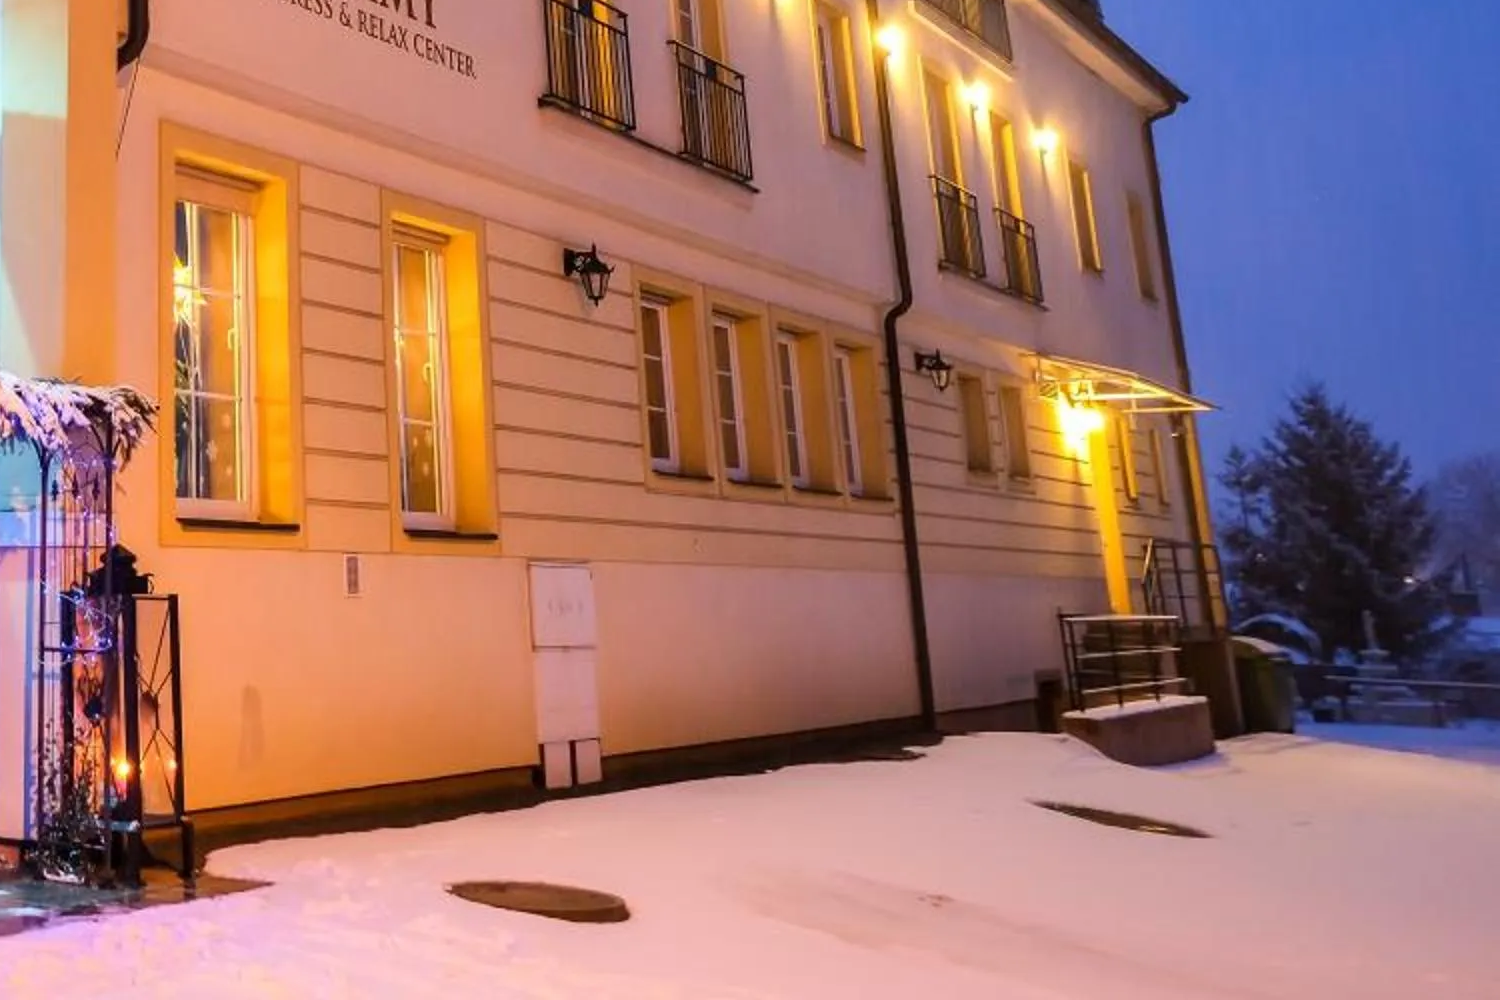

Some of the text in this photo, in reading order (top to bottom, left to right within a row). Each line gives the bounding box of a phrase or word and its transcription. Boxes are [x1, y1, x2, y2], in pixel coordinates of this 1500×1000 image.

[339, 1, 353, 28] &
[358, 8, 409, 52] RELAX
[414, 33, 477, 80] CENTER
